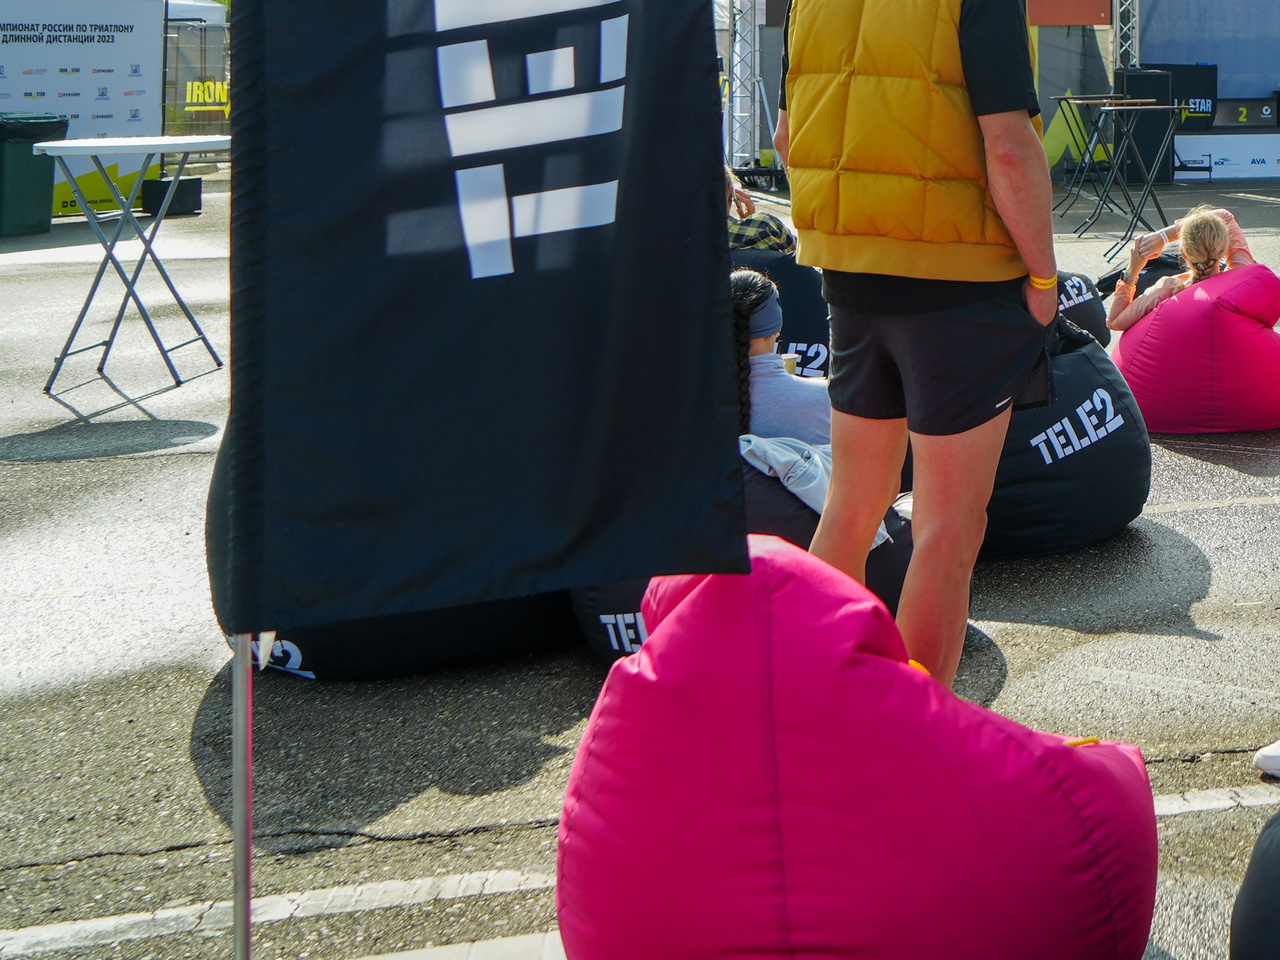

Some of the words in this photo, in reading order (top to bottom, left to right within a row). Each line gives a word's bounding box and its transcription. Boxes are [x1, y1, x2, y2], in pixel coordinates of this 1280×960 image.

[42, 24, 74, 32] РОССИИ
[76, 24, 87, 32] ПО
[89, 24, 134, 33] ТРИАТЛОНУ
[2, 33, 44, 44] ДЛИННОЙ
[46, 35, 95, 45] ДИСТАНЦИИ
[96, 35, 115, 43] 2023
[185, 81, 228, 103] IRON
[1189, 99, 1212, 112] STAR
[1238, 107, 1248, 122] 2
[1058, 276, 1094, 311] LE2
[1030, 388, 1125, 465] TELE2
[599, 611, 650, 653] TEL
